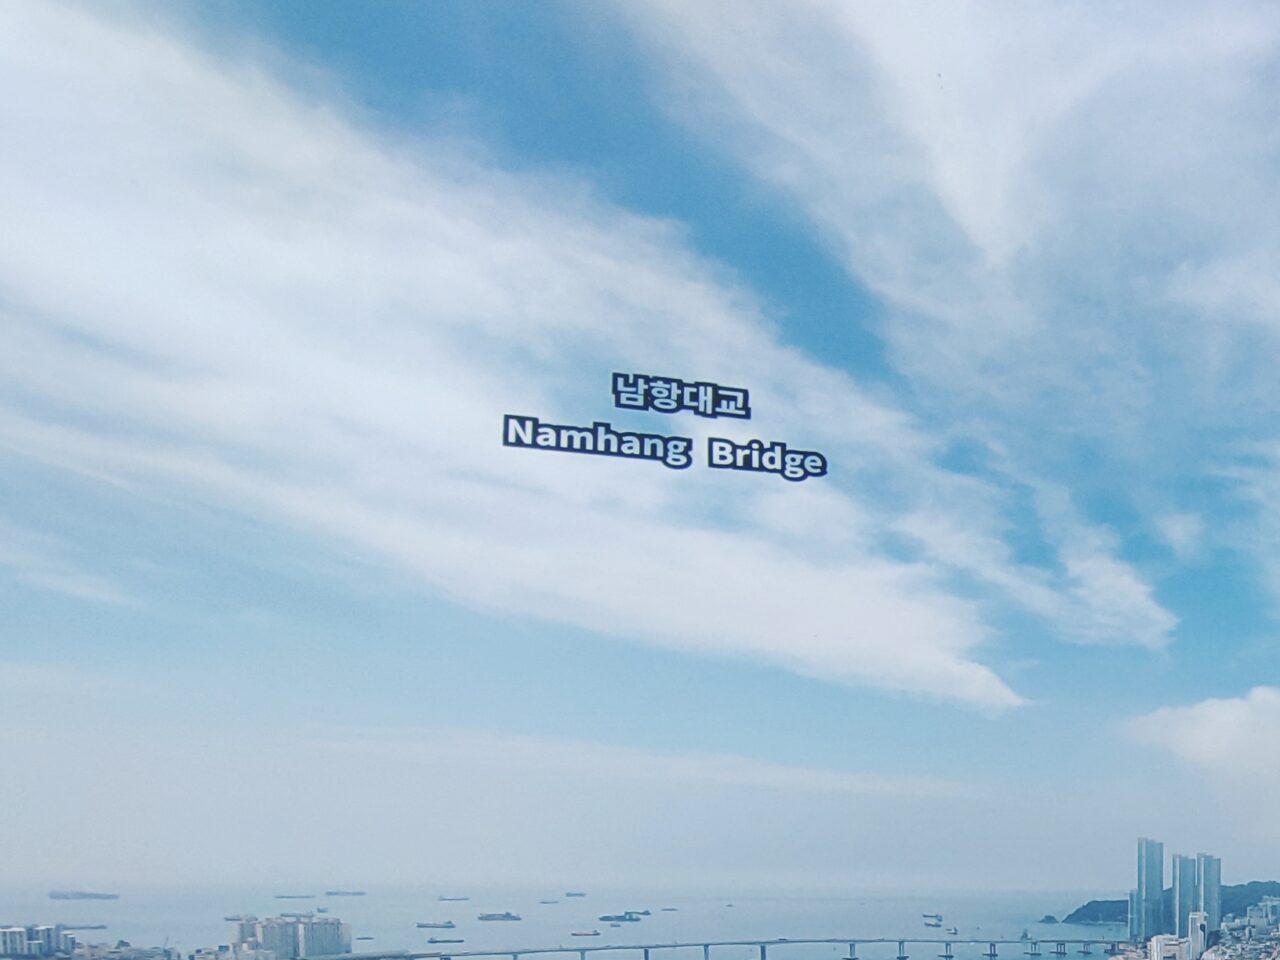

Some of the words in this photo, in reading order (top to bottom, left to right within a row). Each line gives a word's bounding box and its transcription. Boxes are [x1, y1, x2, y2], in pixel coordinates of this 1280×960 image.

[613, 374, 750, 418] 남항대교
[504, 416, 692, 468] Namhang
[708, 438, 827, 481] Bridge
